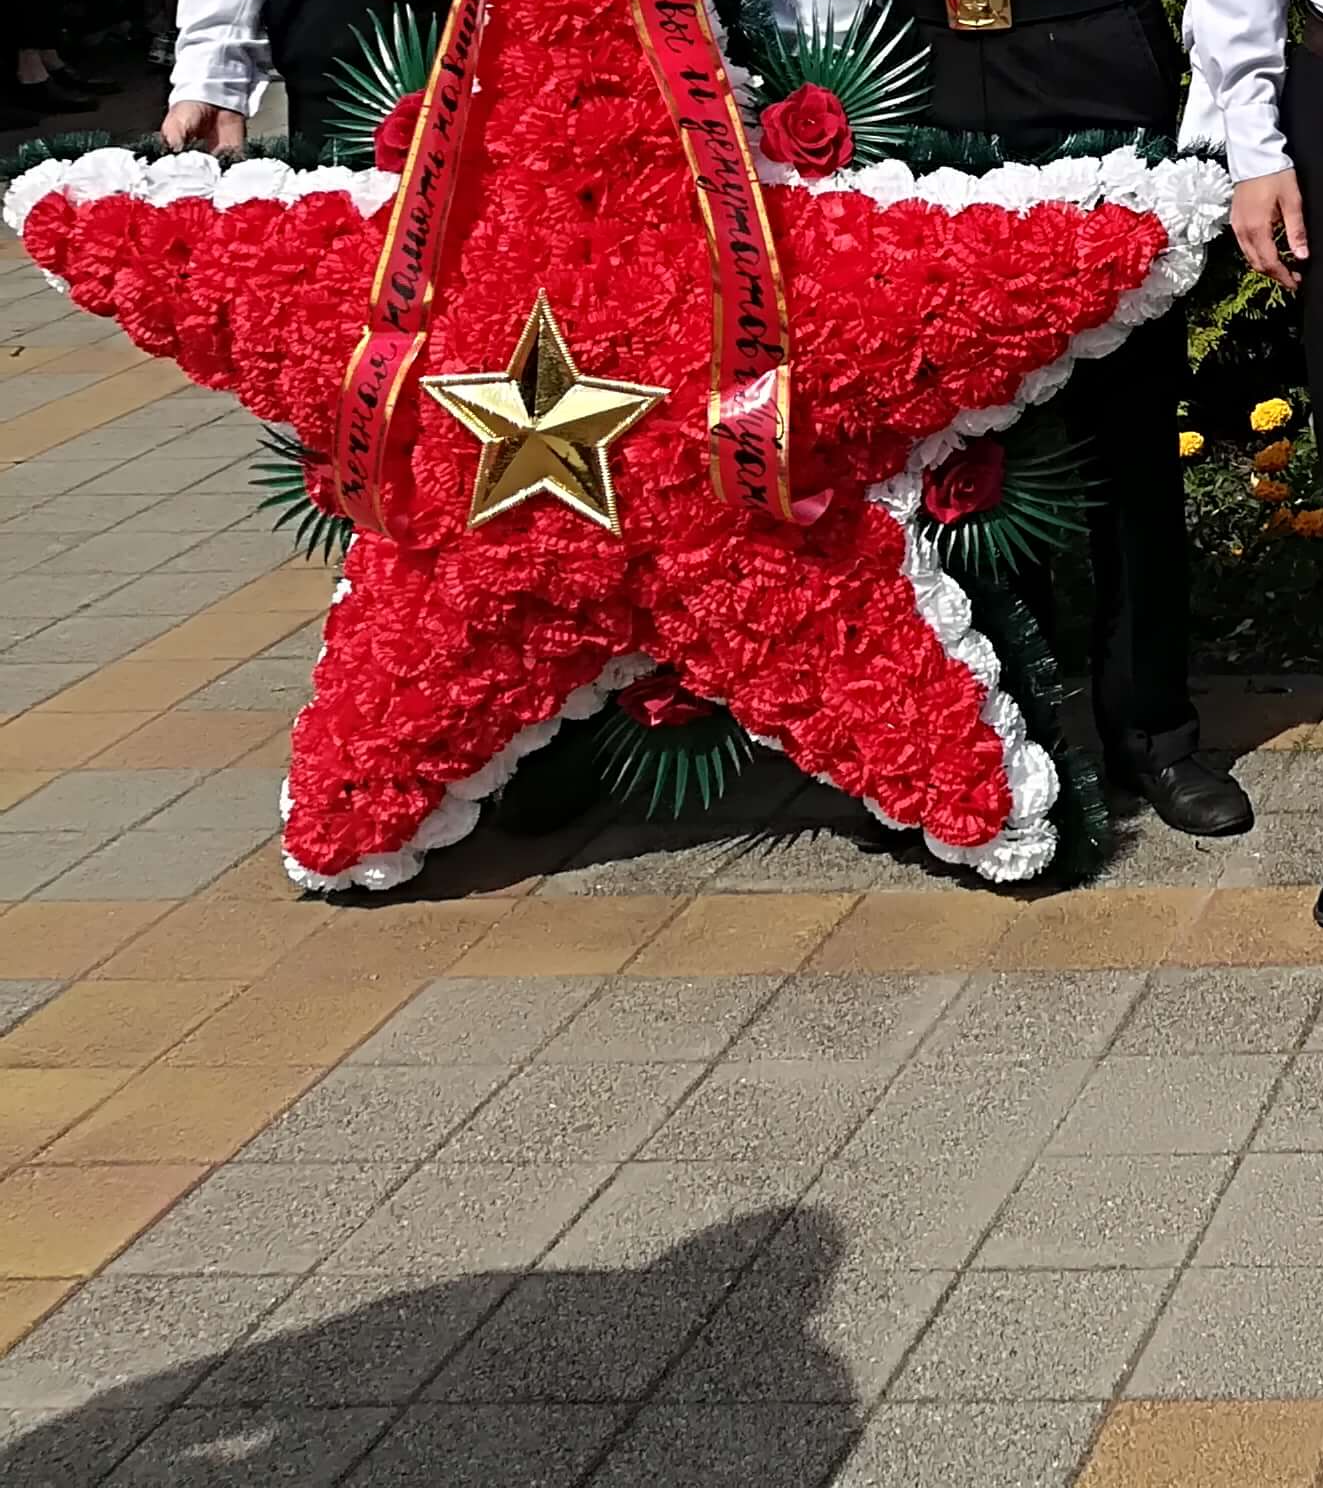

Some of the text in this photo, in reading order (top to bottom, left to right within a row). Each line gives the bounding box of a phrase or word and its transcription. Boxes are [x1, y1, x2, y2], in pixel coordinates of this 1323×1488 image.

[679, 63, 717, 105] и
[383, 150, 445, 333] память
[679, 117, 785, 361] депутатов
